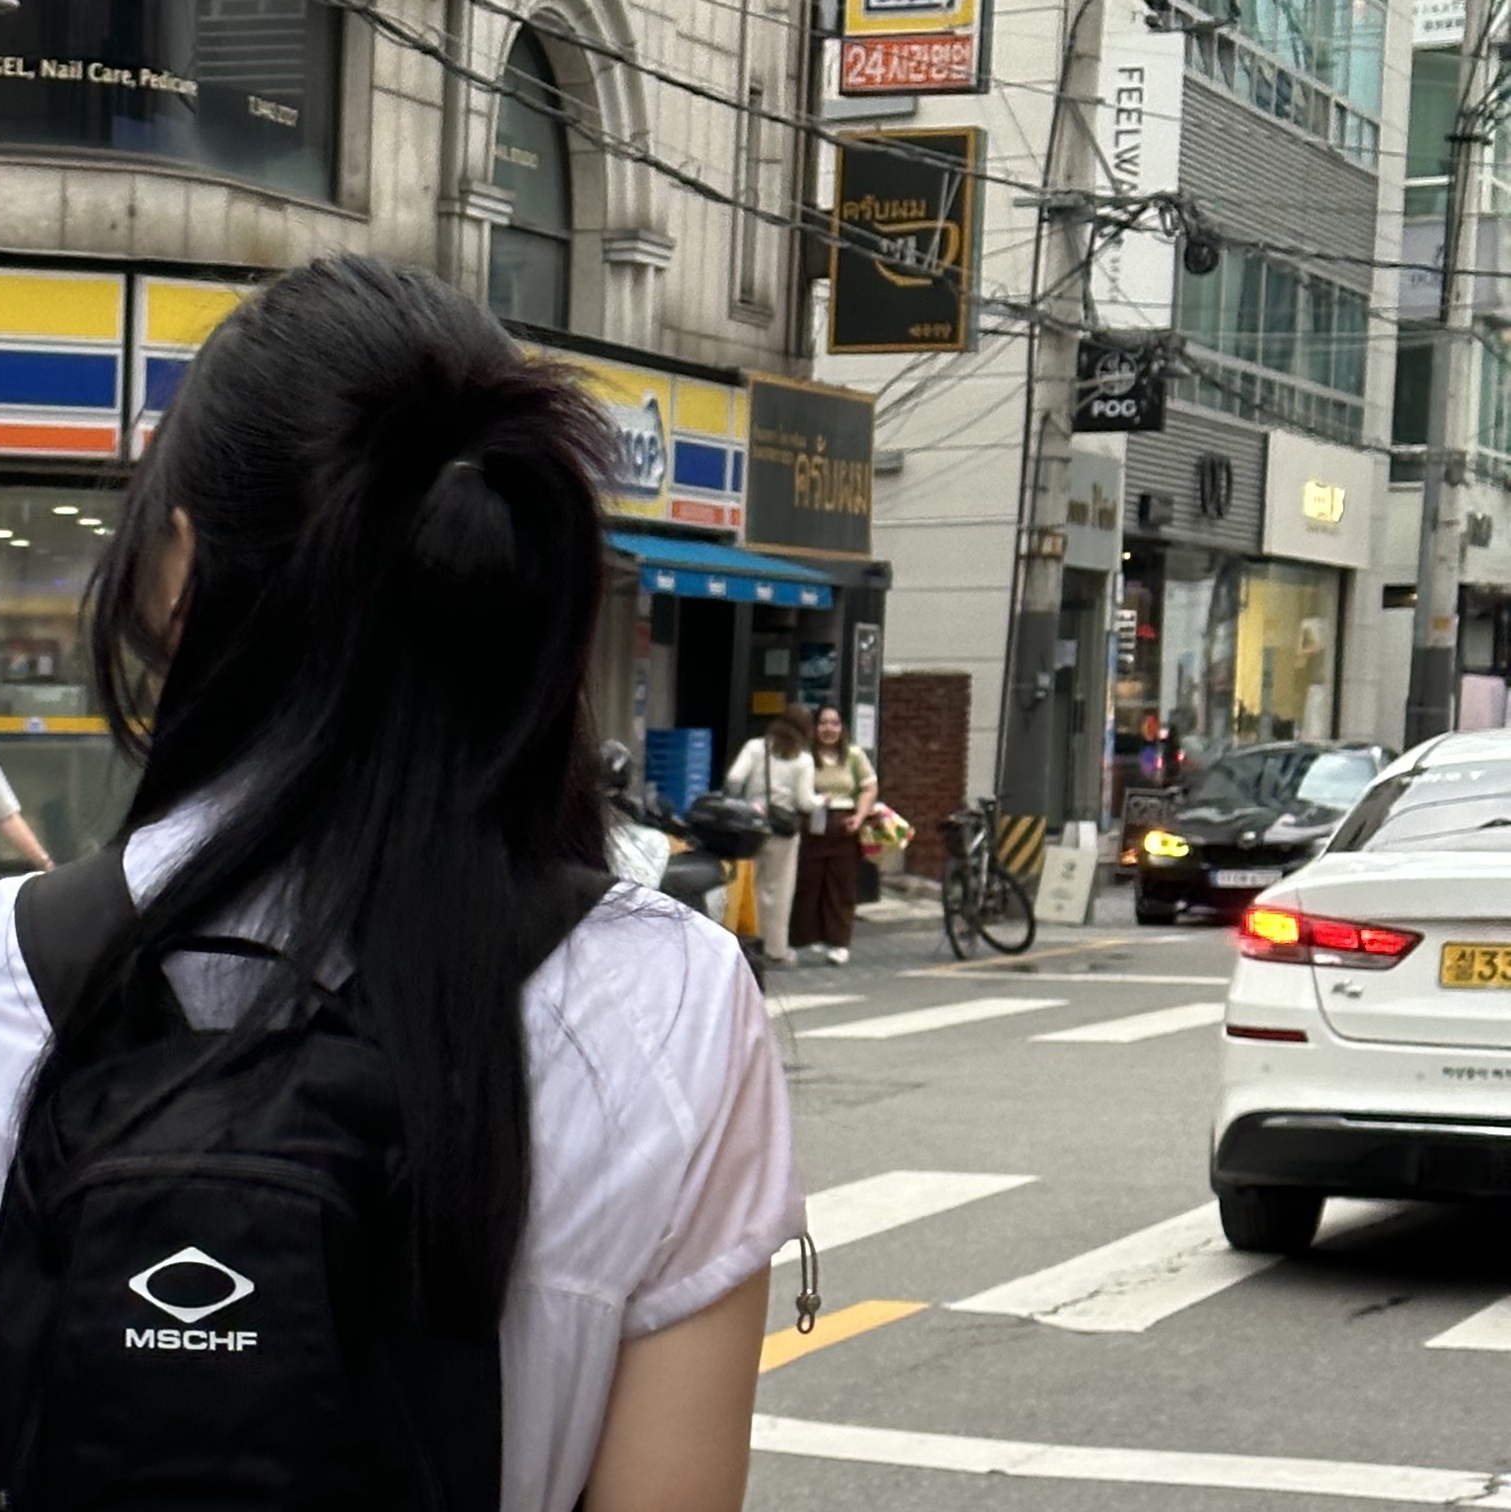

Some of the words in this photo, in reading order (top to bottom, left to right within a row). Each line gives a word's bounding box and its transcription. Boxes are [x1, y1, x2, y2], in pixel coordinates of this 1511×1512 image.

[41, 59, 84, 80] Nail
[88, 62, 137, 88] Care,
[1113, 66, 1144, 217] FEELWA
[124, 1327, 258, 1352] MSCHF
